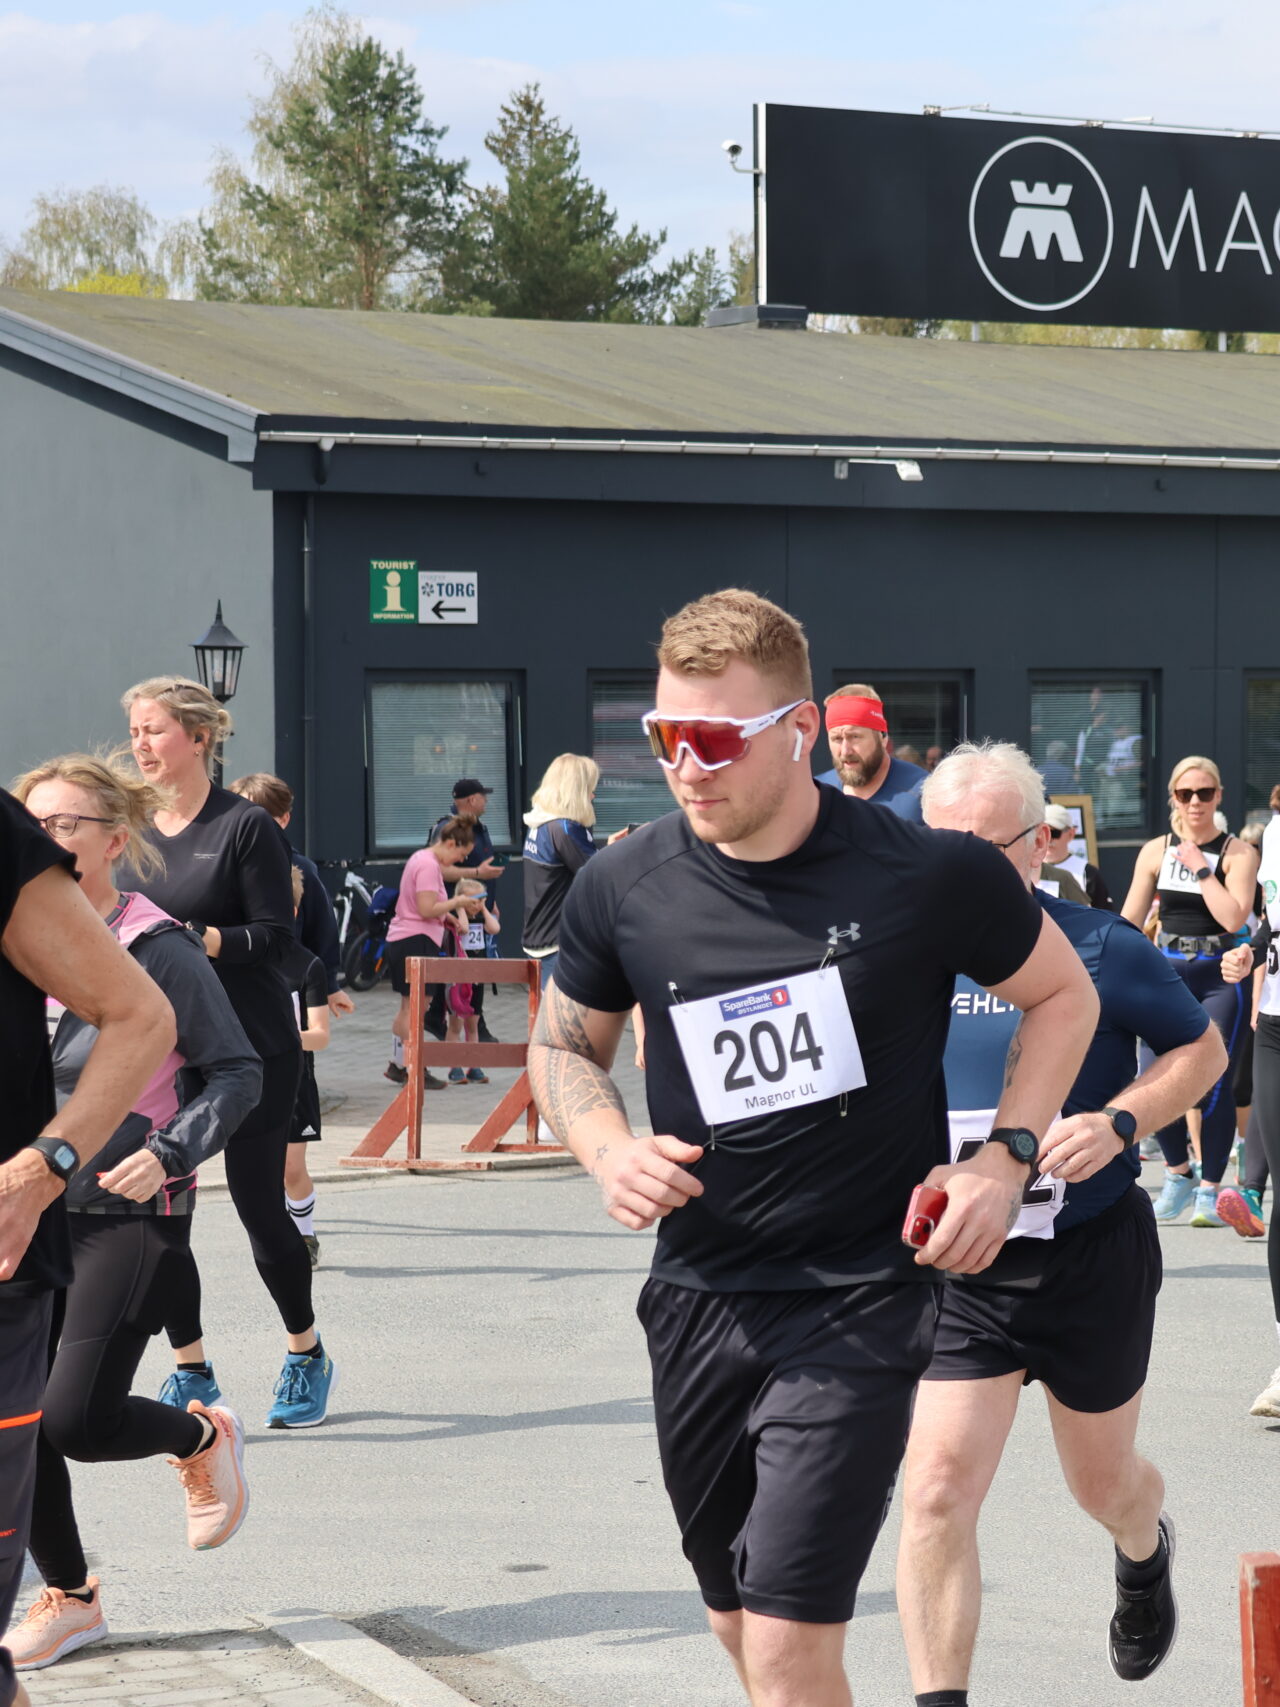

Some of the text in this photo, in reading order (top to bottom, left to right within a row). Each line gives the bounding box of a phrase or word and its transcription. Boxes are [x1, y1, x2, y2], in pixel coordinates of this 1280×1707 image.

[371, 561, 416, 570] TOURIST
[437, 583, 475, 597] TORG
[723, 993, 771, 1012] SpareBank
[714, 1012, 824, 1092] 204
[745, 1082, 818, 1109] Magnor UL
